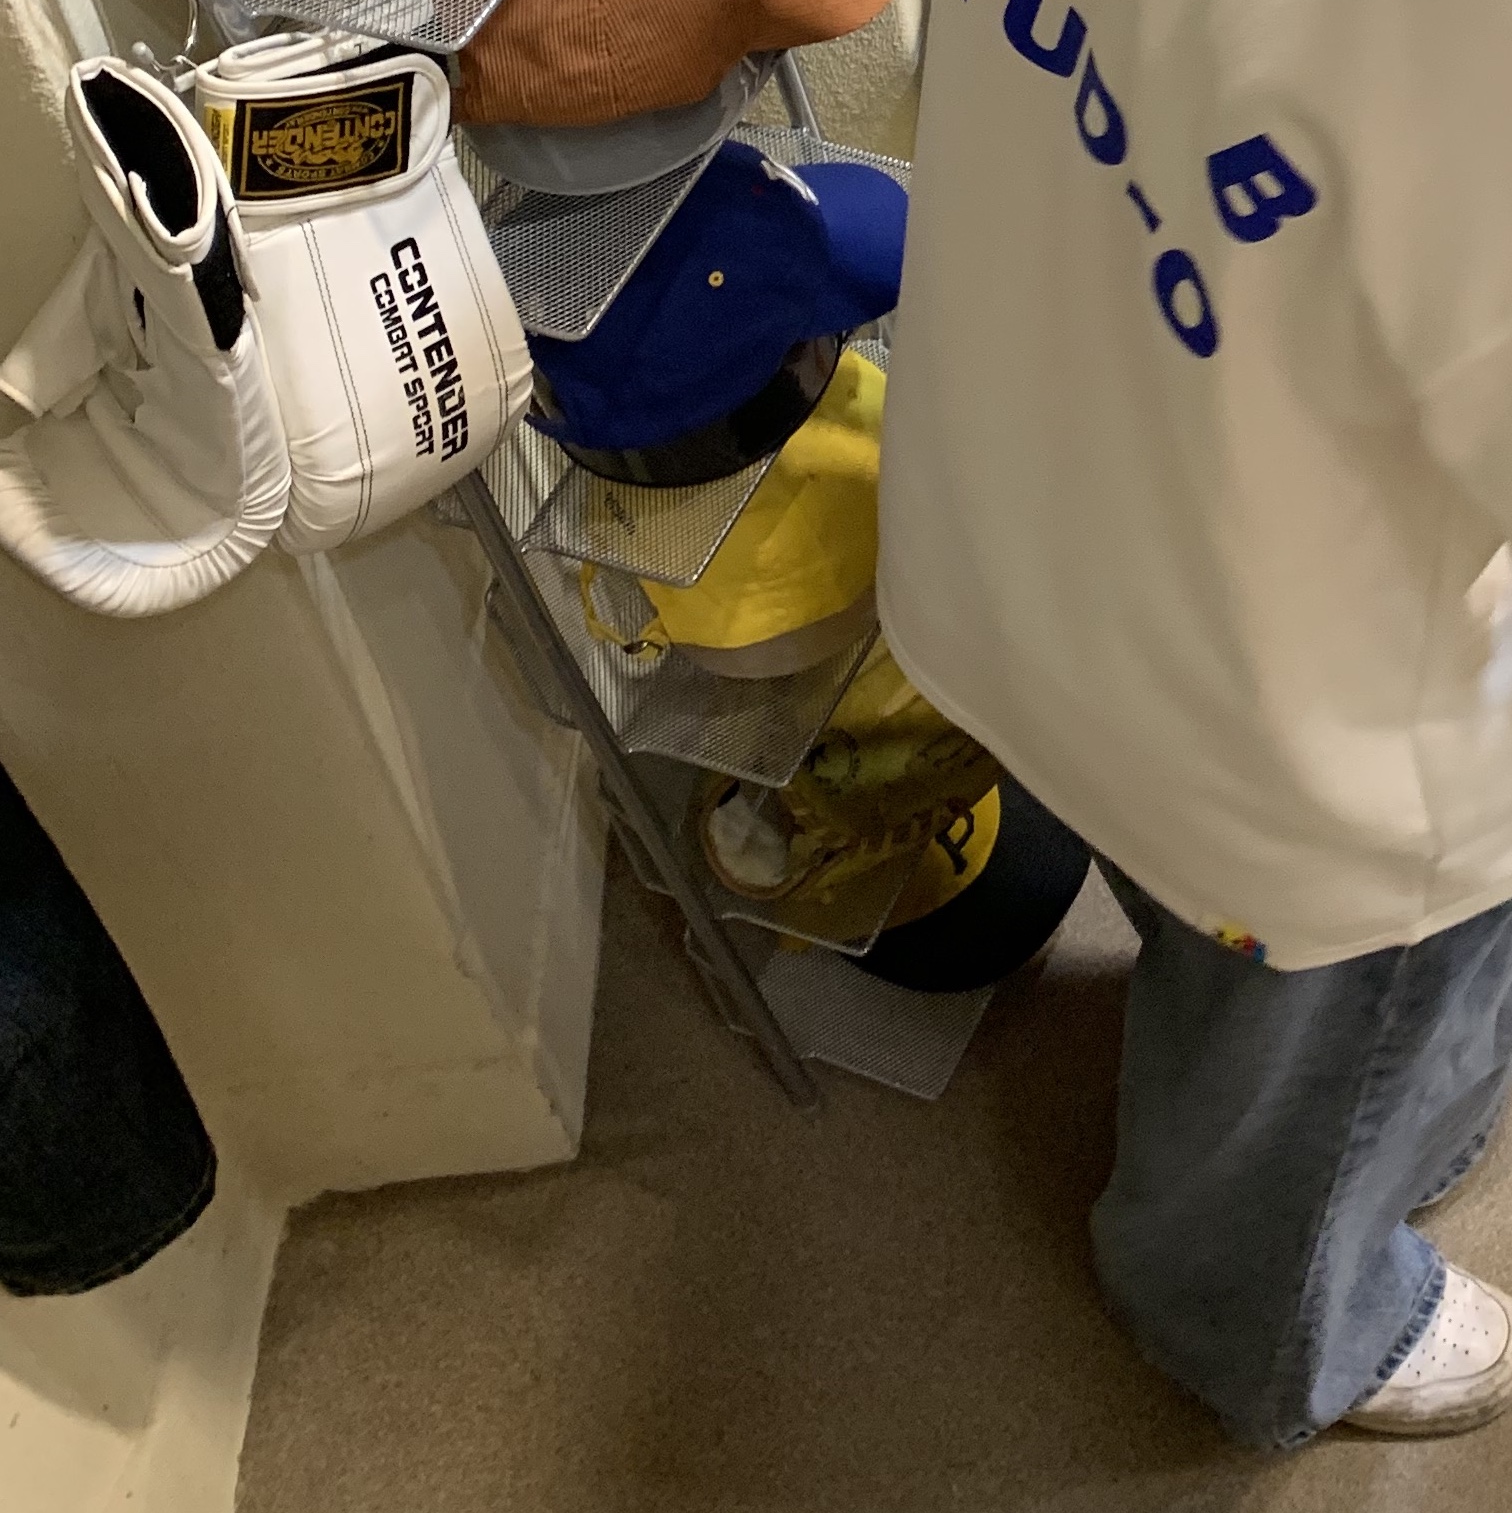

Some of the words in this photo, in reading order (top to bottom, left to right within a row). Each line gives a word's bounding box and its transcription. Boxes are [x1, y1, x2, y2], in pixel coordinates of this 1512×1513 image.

[252, 110, 397, 156] CONTENDER
[369, 272, 419, 375] COMBAT
[403, 376, 435, 458] SPORT
[390, 236, 470, 463] CONTENDER
[935, 797, 976, 877] P
